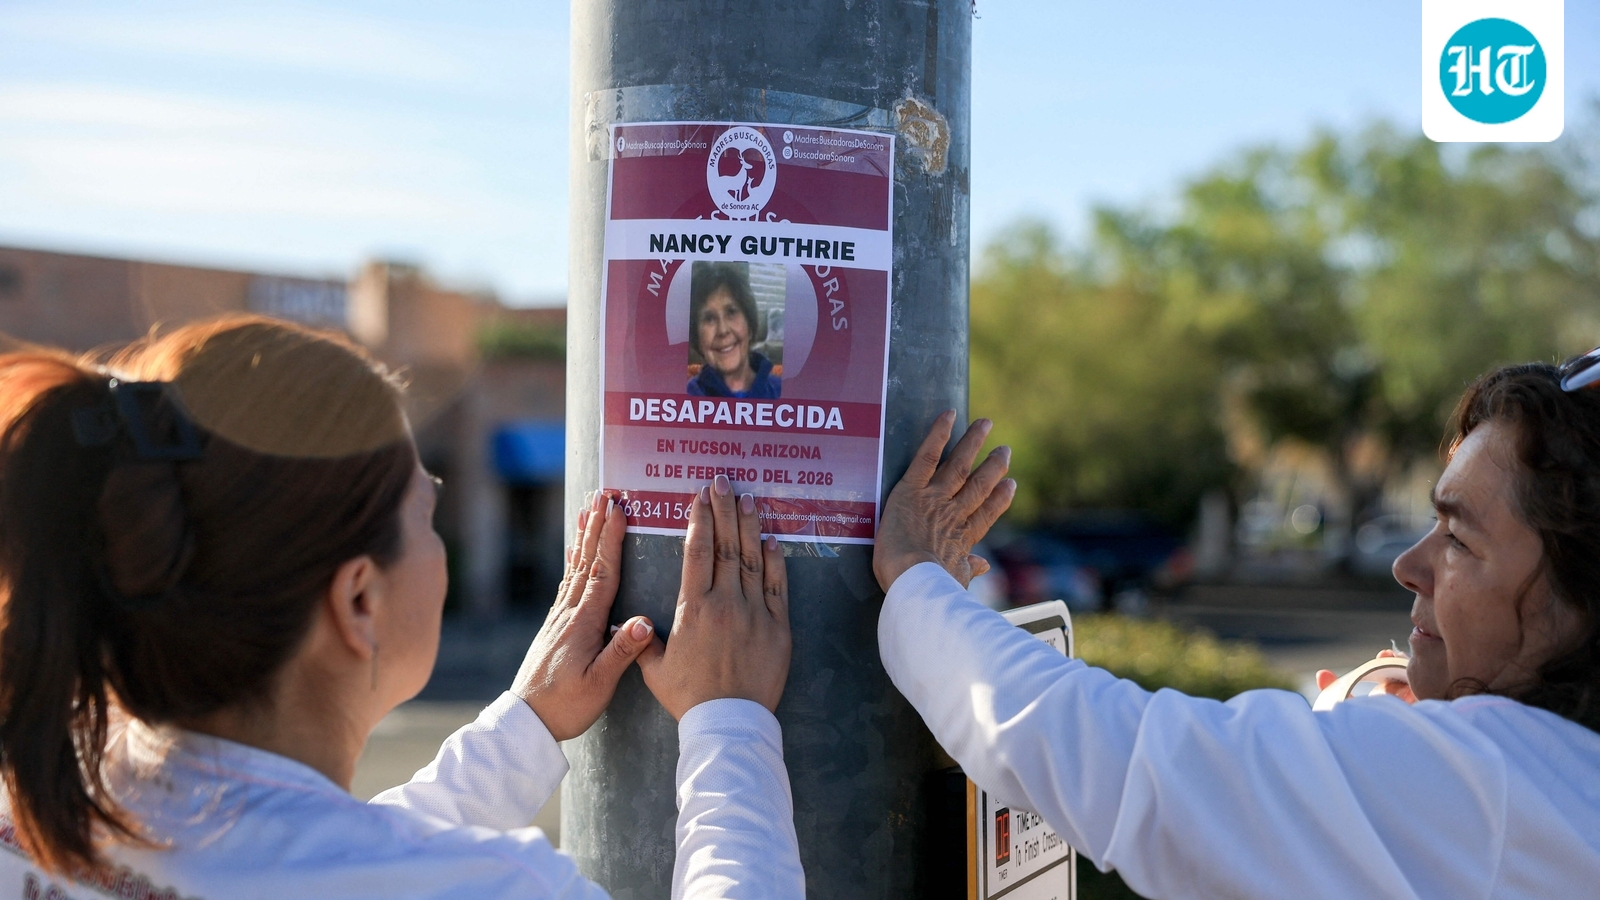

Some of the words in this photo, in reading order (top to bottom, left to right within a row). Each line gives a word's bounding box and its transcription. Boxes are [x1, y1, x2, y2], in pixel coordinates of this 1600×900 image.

[625, 139, 707, 150] MadresBuscadorasDeSonora
[709, 134, 733, 168] MADRES
[734, 132, 775, 170] BUSCADORAS
[794, 134, 884, 152] MadresBuscadorasDeSonora
[794, 149, 855, 163] BuscadoraSonora
[650, 233, 732, 254] NANCY
[740, 235, 855, 261] GUTHRIE
[630, 398, 844, 430] DESAPARECIDA
[656, 439, 675, 453] EN
[679, 440, 746, 458] TUCSON,
[751, 443, 822, 460] ARIZONA
[645, 463, 660, 478] 01
[665, 465, 682, 478] DE
[763, 469, 792, 484] DEL
[797, 471, 833, 486] 2026
[758, 511, 871, 525] dresbuscadorasdesonora@gmail.com
[1016, 811, 1030, 834] TIME
[1015, 844, 1022, 868] To
[1024, 836, 1040, 863] Finish
